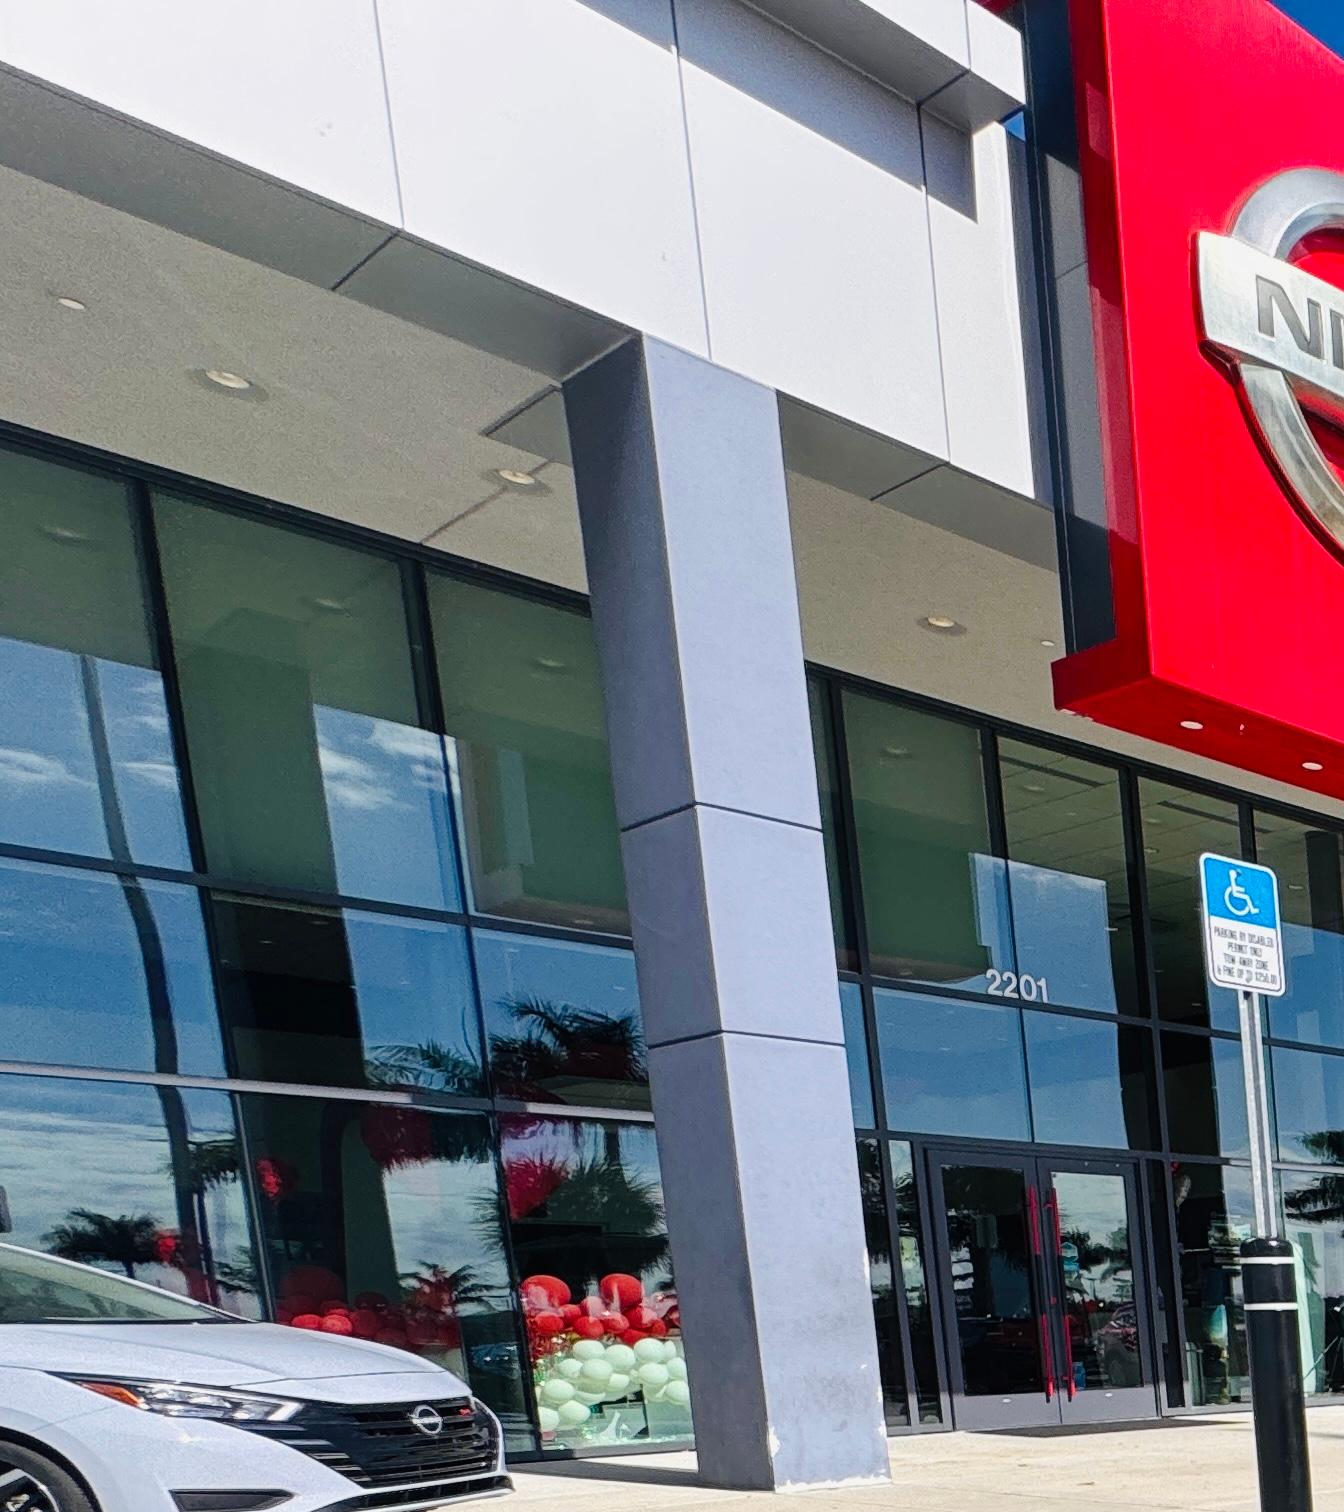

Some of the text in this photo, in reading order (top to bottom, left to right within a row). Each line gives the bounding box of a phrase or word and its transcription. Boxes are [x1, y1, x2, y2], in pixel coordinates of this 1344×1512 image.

[1214, 926, 1238, 941] PARKING
[1248, 933, 1274, 948] DISABLED
[1228, 942, 1248, 954] PERMIT
[1223, 953, 1236, 965] TOW
[1255, 959, 1269, 971] ZONE
[985, 968, 1049, 1004] 2201
